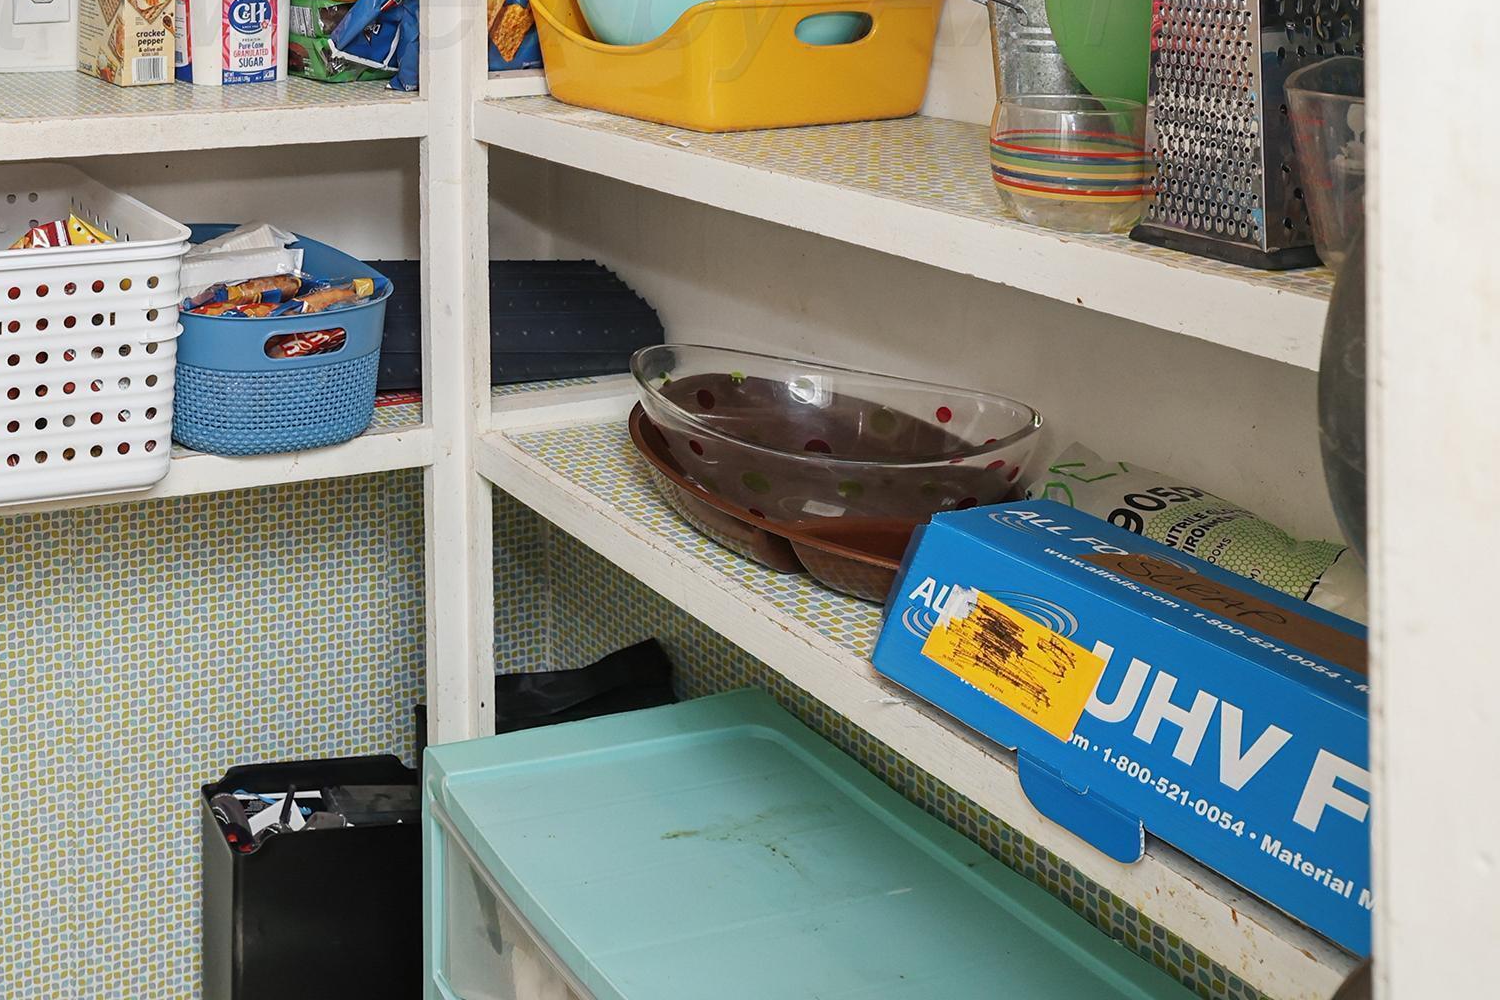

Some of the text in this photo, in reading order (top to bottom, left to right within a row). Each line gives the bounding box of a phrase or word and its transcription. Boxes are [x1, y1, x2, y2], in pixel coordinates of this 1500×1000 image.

[233, 3, 266, 24] C&H
[136, 28, 166, 38] cracked
[137, 37, 165, 47] pepper
[233, 49, 269, 57] GRANULATED
[239, 57, 264, 67] SUGAR
[1003, 507, 1064, 538] ALL
[1115, 556, 1289, 626] SCRAP
[1043, 545, 1342, 680] www.allfoils.com 1-800-521-0054
[1083, 639, 1295, 793] UHV
[1102, 748, 1355, 899] 1-800-521-0054 Material
